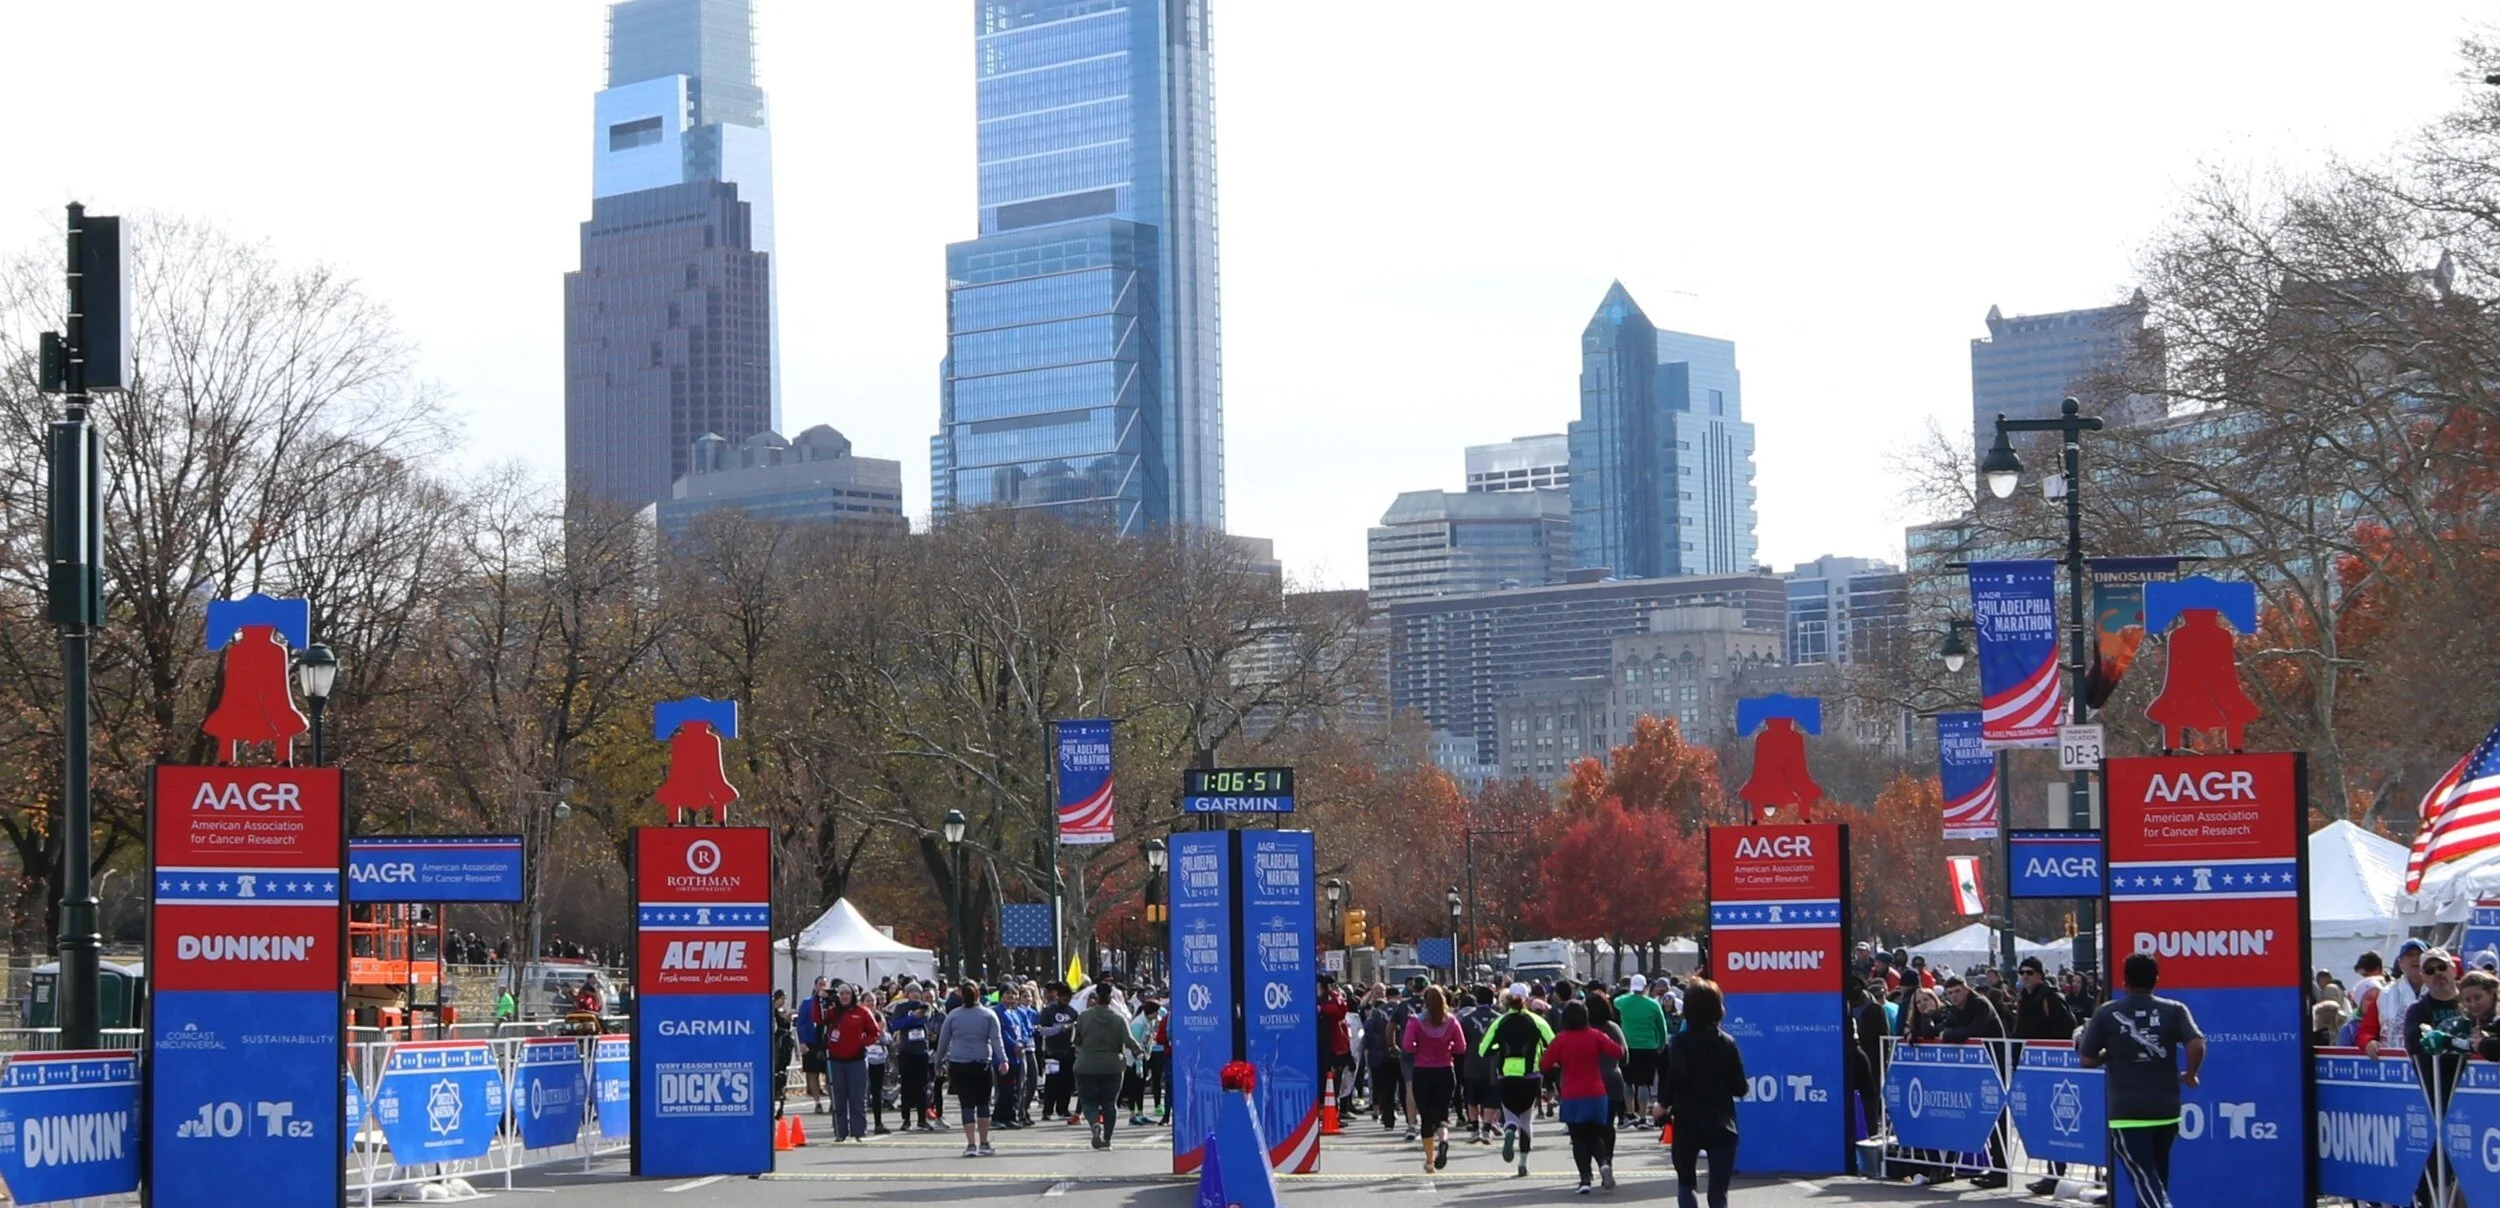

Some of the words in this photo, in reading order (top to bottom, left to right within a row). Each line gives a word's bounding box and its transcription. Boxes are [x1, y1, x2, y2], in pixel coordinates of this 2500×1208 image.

[1978, 599, 2051, 616] PHILADELPHIA
[1995, 616, 2052, 632] MARATHON
[1062, 744, 1110, 754] PHILADELPHIA
[1943, 738, 1982, 749] PHILADELP
[1073, 754, 1110, 765] MARATHON
[2064, 745, 2100, 765] DE-3
[2144, 771, 2256, 803] AACR
[192, 782, 303, 811] AACR
[1195, 798, 1278, 811] GARMIN
[2144, 812, 2195, 824] American
[2197, 810, 2259, 821] Association
[191, 820, 241, 831] American
[244, 820, 304, 832] Association
[2144, 826, 2159, 838] for
[2162, 826, 2199, 837] Cancer
[2202, 825, 2251, 836] Research
[191, 834, 206, 844] for
[209, 834, 245, 845] Cancer
[248, 835, 296, 845] Research
[1734, 836, 1813, 858] AACR
[422, 863, 460, 872] American
[462, 863, 508, 872] Association
[1182, 854, 1218, 871] PHILADELPHIA
[1257, 853, 1299, 869] PHILADELPHIA
[2025, 857, 2099, 877] AACR
[348, 863, 417, 883] AACR
[422, 874, 433, 882] for
[435, 874, 463, 882] Cancer
[465, 874, 502, 882] Research
[1266, 870, 1300, 886] MARATHON
[1734, 875, 1746, 883] for
[1775, 875, 1809, 883] Research
[667, 876, 741, 887] ROTHMAN
[177, 935, 315, 962] DUNKIN'
[2133, 929, 2274, 957] DUNKIN'
[660, 941, 747, 969] ACME
[1727, 950, 1825, 971] DUNKIN'
[1183, 1016, 1219, 1026] ROTHMAN
[1259, 1013, 1300, 1025] ROTHMAN
[658, 1020, 751, 1036] GARMIN
[1775, 1025, 1841, 1033] SUSTAINABILITY
[166, 1032, 215, 1041] COMCAST
[241, 1034, 335, 1044] SUSTAINABILITY
[155, 1041, 226, 1049] NBCUNIVERSAL
[681, 1062, 712, 1070] SEASON
[661, 1071, 748, 1105] DICK'S
[1923, 1090, 1973, 1110] ROTHMAN
[662, 1105, 711, 1113] SPORTING
[713, 1104, 748, 1112] GOODS
[23, 1110, 128, 1168] DUNKIN'
[2317, 1110, 2400, 1168] DUNKIN'
